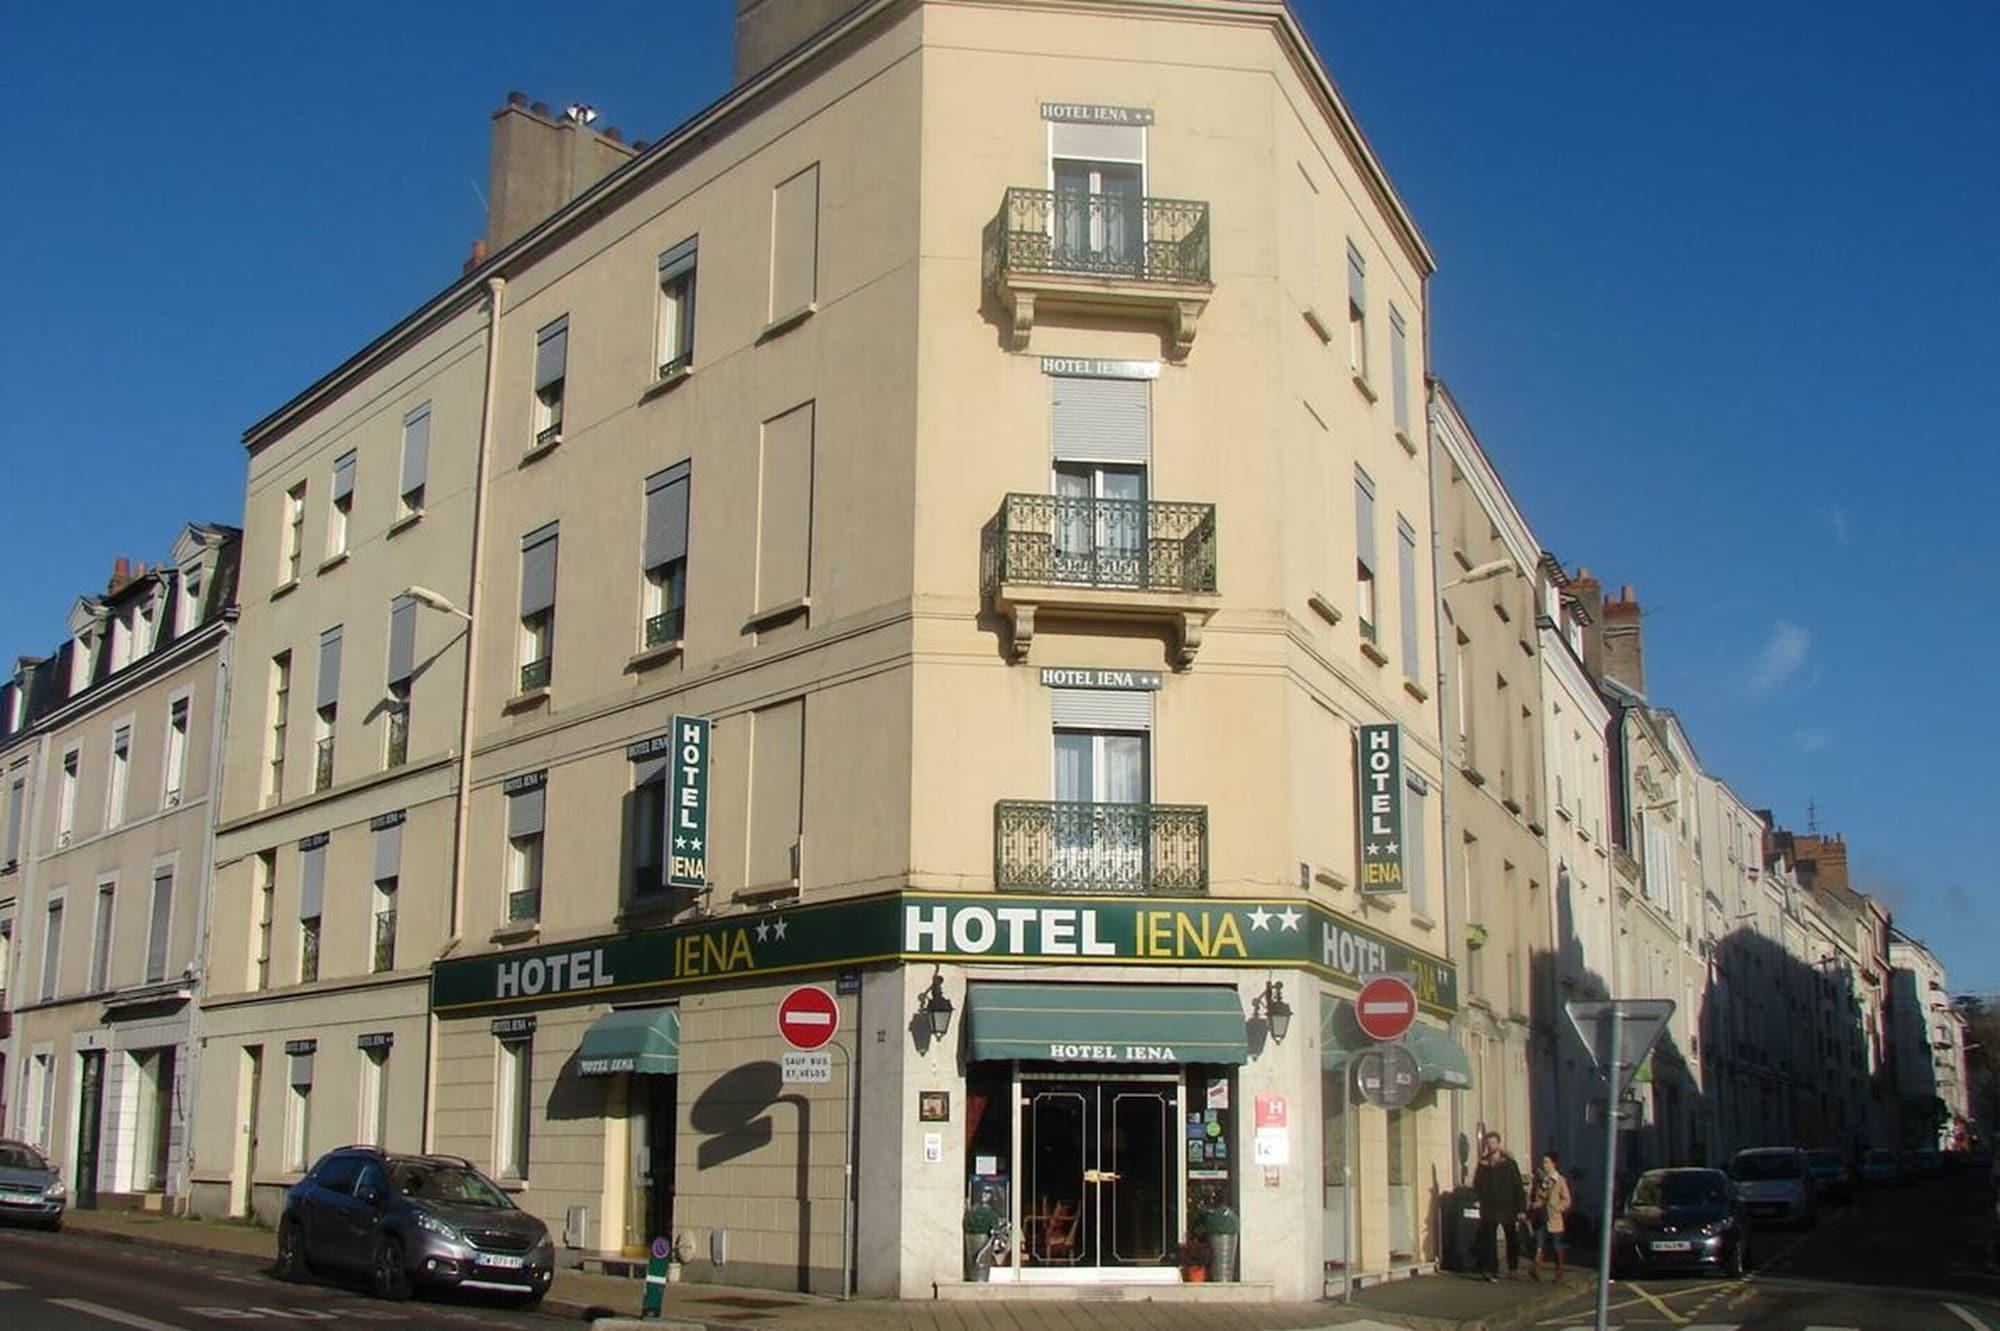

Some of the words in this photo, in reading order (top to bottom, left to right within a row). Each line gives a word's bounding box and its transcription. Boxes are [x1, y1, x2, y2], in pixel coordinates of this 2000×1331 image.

[1042, 104, 1090, 119] HOTEL
[1094, 107, 1128, 121] IENA
[1043, 358, 1093, 374] HOTEL
[1042, 669, 1094, 686] HOTEL
[1098, 671, 1134, 687] IENA
[680, 723, 700, 829] HOTEL
[1369, 730, 1392, 835] HOTEL
[671, 855, 705, 880] IENA
[1363, 861, 1401, 884] IENA
[904, 905, 1116, 955] HOTEL
[1135, 910, 1248, 958] IENA
[496, 948, 614, 999] HOTEL
[674, 927, 755, 978] IENA
[785, 1057, 806, 1066] SAUF
[810, 1057, 829, 1066] BUS
[1050, 1044, 1117, 1060] HOTEL
[1125, 1046, 1177, 1061] IENA
[786, 1070, 797, 1078] ET
[1268, 1099, 1284, 1115] H
